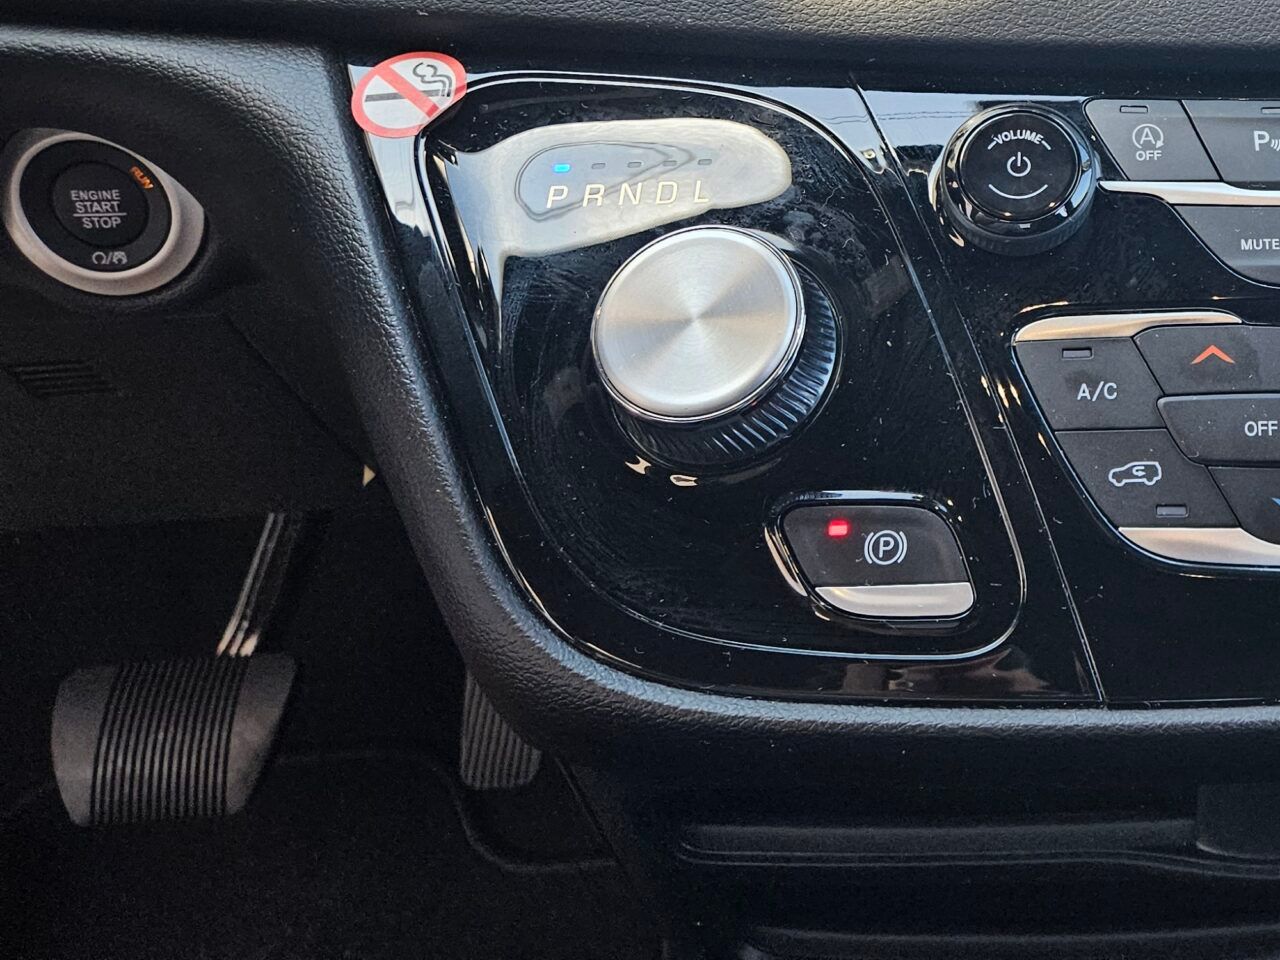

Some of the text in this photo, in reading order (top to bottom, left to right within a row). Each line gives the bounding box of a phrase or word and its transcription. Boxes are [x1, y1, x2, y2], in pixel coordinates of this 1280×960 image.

[993, 129, 1044, 145] VOLUME
[1136, 150, 1162, 162] OFF
[71, 189, 121, 201] ENGINE
[75, 201, 120, 213] START
[83, 217, 122, 229] STOP
[1240, 238, 1280, 251] MUTE
[1076, 380, 1118, 403] A/C
[1244, 420, 1279, 437] OFF
